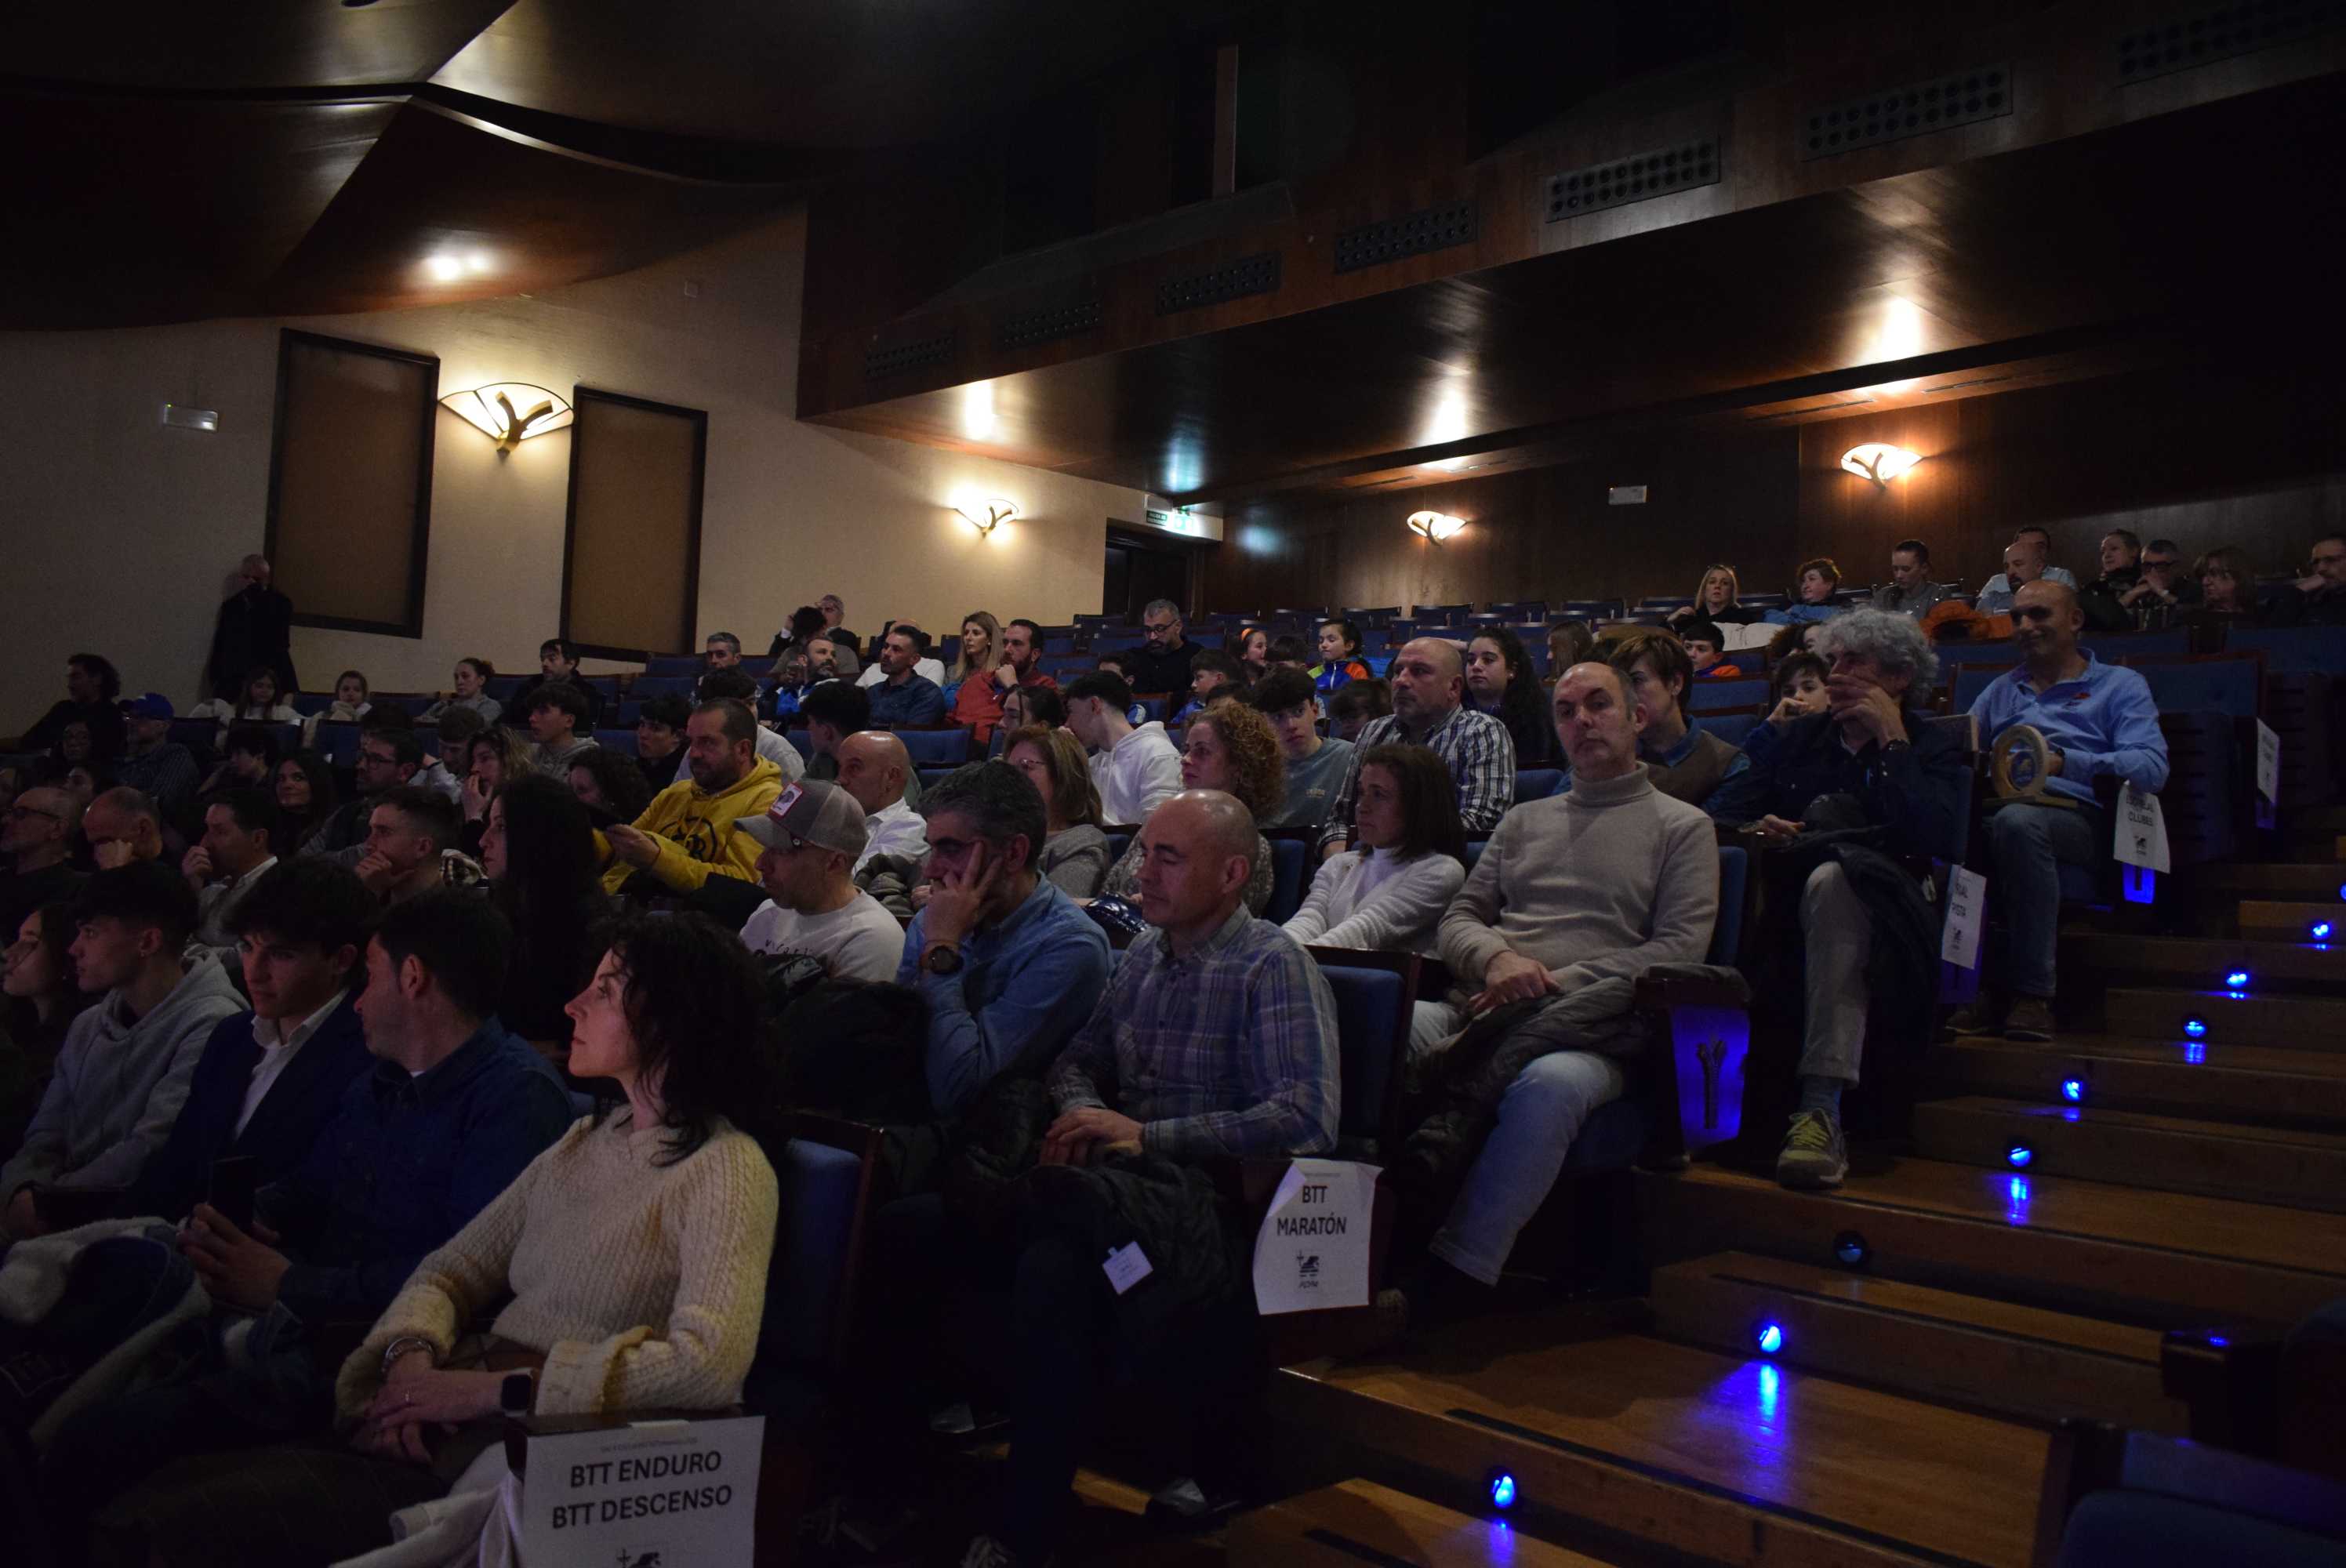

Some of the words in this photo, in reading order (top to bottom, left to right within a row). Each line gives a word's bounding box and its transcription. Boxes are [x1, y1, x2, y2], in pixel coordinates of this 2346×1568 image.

[1302, 1185, 1328, 1204] BTT
[1276, 1212, 1347, 1236] MARATÓN
[570, 1461, 614, 1489] BTT
[618, 1450, 722, 1483] ENDURO
[552, 1501, 596, 1530] BTT
[601, 1484, 732, 1523] DESCENSO
